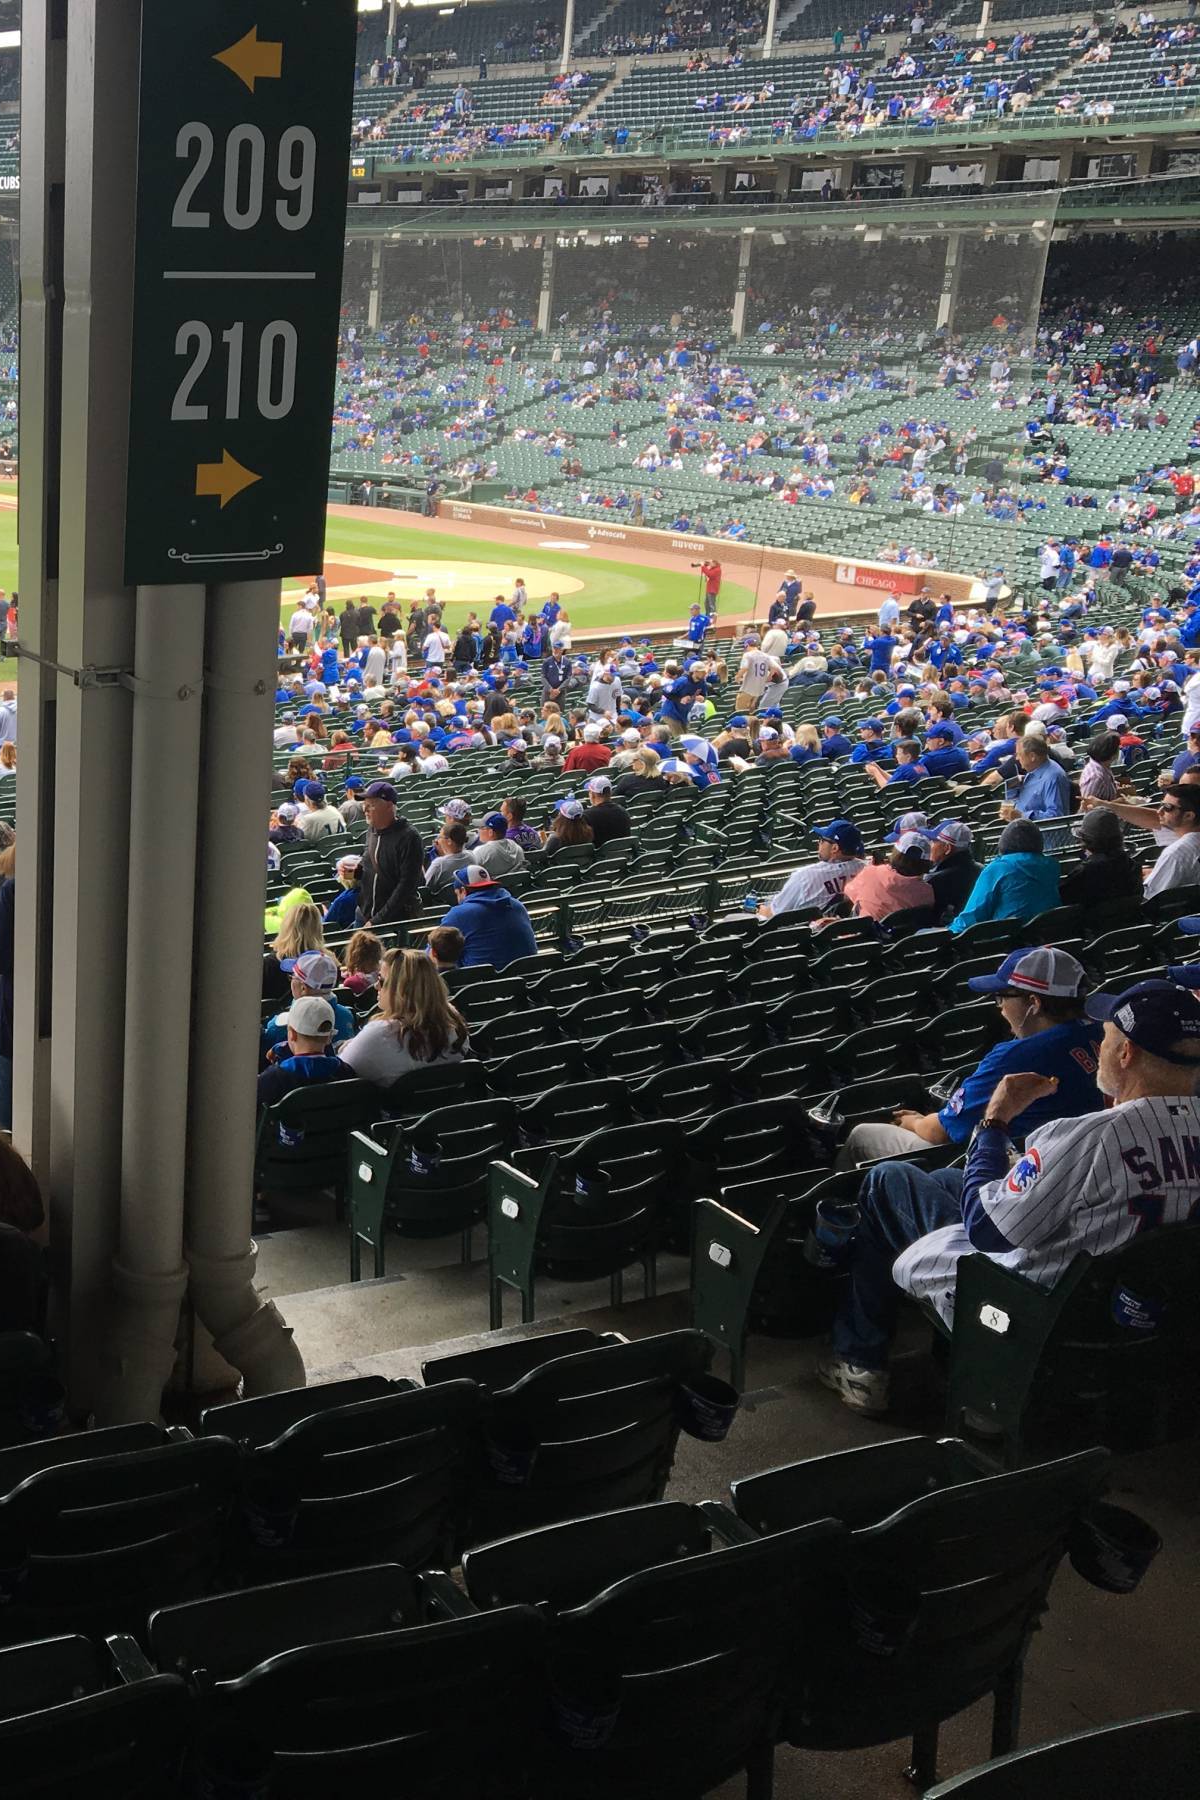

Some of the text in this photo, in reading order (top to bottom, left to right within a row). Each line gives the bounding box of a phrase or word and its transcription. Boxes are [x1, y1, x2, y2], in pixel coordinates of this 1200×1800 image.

[171, 121, 316, 231] 209
[170, 319, 298, 421] 210
[597, 528, 626, 540] Advocate
[672, 539, 705, 551] nuveen
[855, 575, 897, 589] CHICAGO
[754, 662, 767, 678] 19
[717, 1247, 725, 1261] 7
[989, 1311, 1000, 1326] 8
